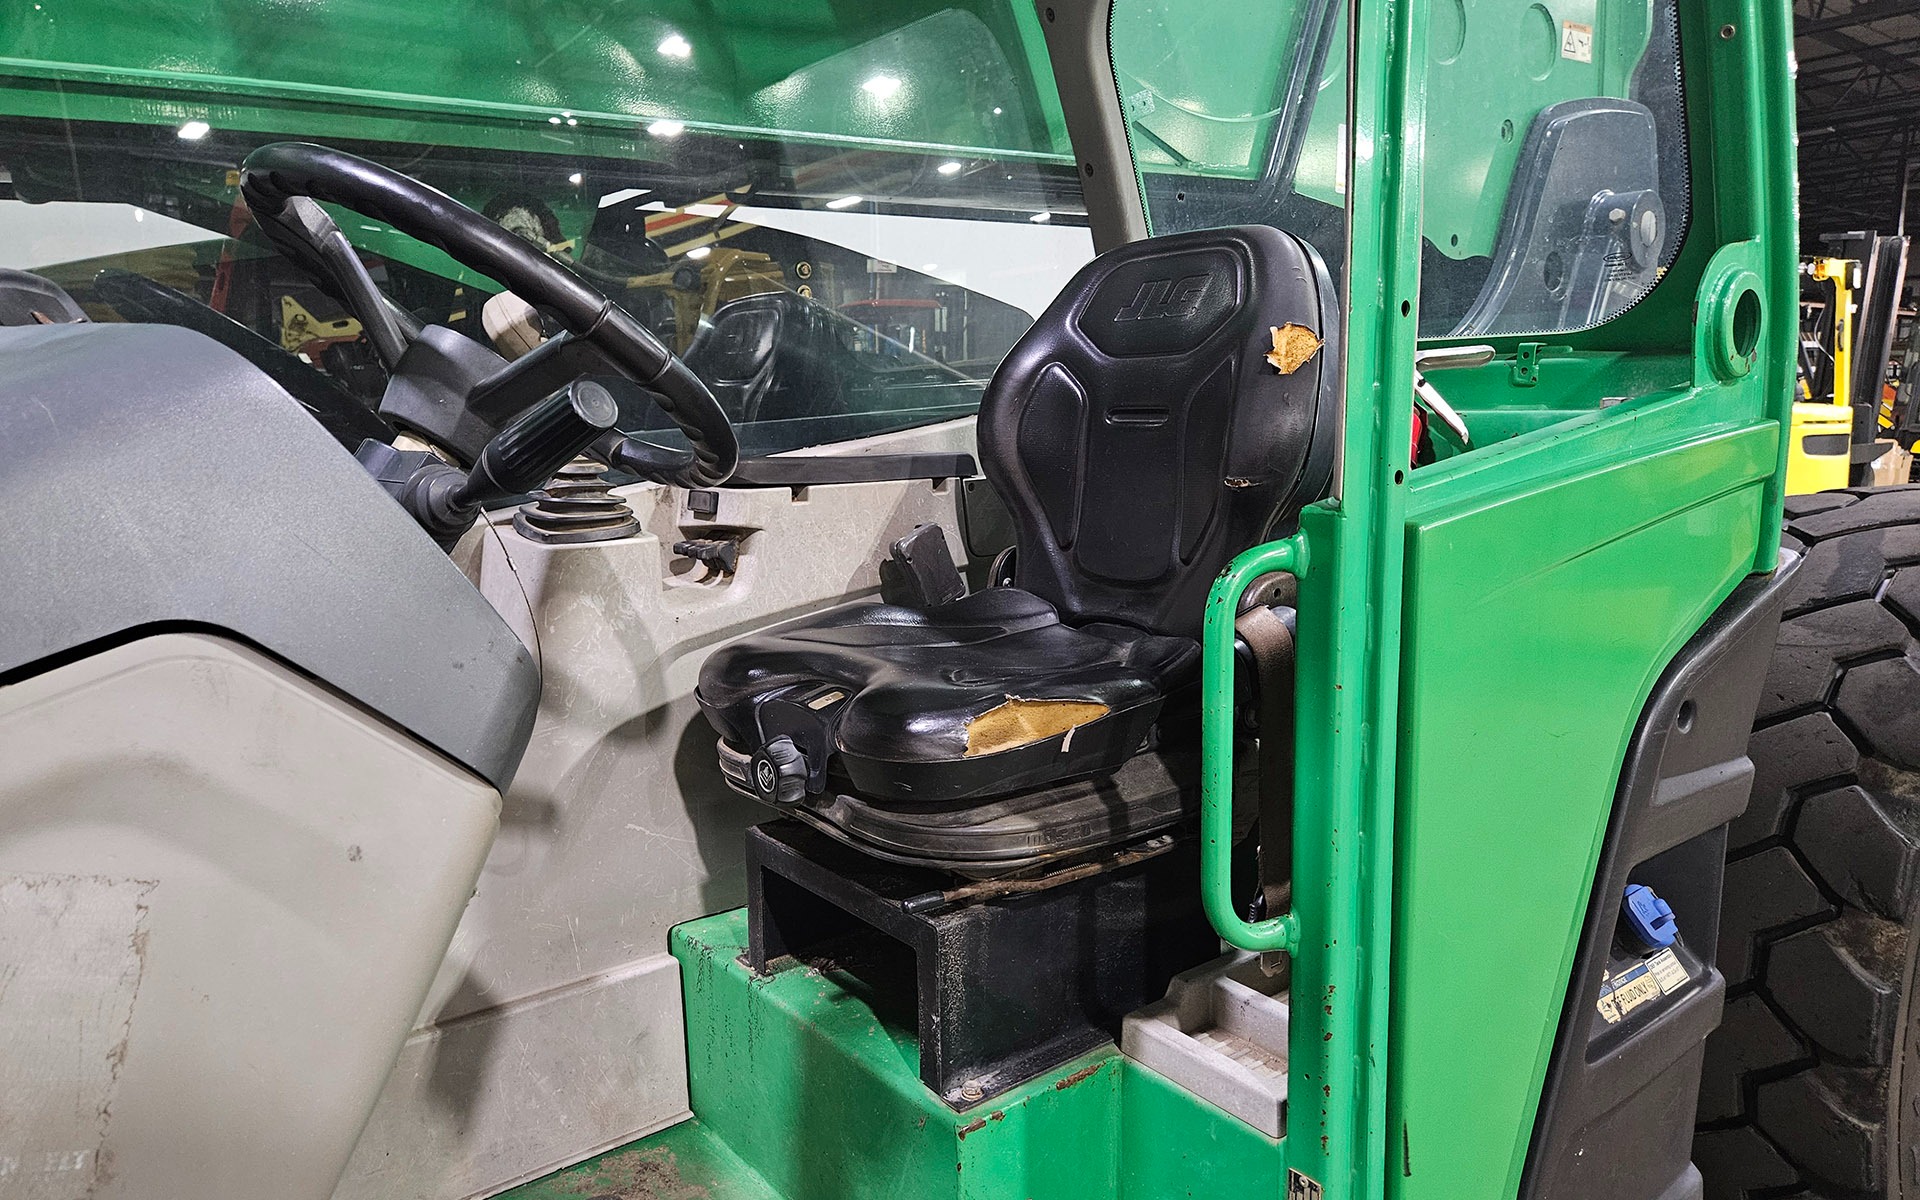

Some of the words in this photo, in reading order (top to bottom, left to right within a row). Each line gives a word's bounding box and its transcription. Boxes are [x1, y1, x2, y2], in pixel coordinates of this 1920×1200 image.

[1113, 273, 1213, 322] JLG
[1620, 988, 1637, 1005] FLUID
[1634, 981, 1649, 997] ONLY
